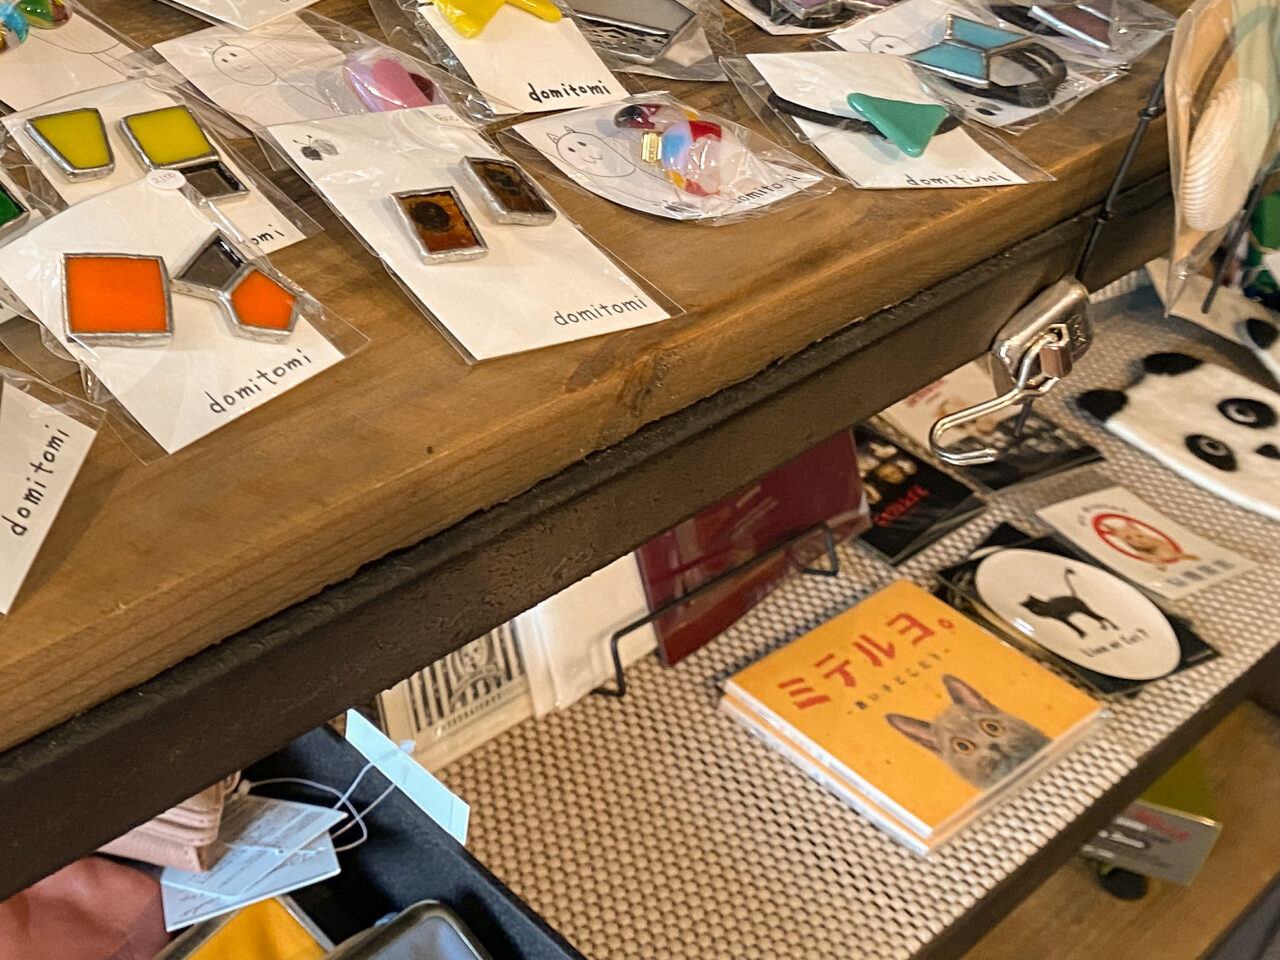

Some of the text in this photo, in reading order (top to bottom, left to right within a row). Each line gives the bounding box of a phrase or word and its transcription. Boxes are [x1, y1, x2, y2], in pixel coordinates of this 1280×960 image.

[526, 81, 611, 103] domitomi
[553, 296, 648, 326] domitomi
[205, 349, 312, 414] domitomi
[1, 425, 70, 536] domitomi
[778, 612, 956, 710] ミテルヨ。
